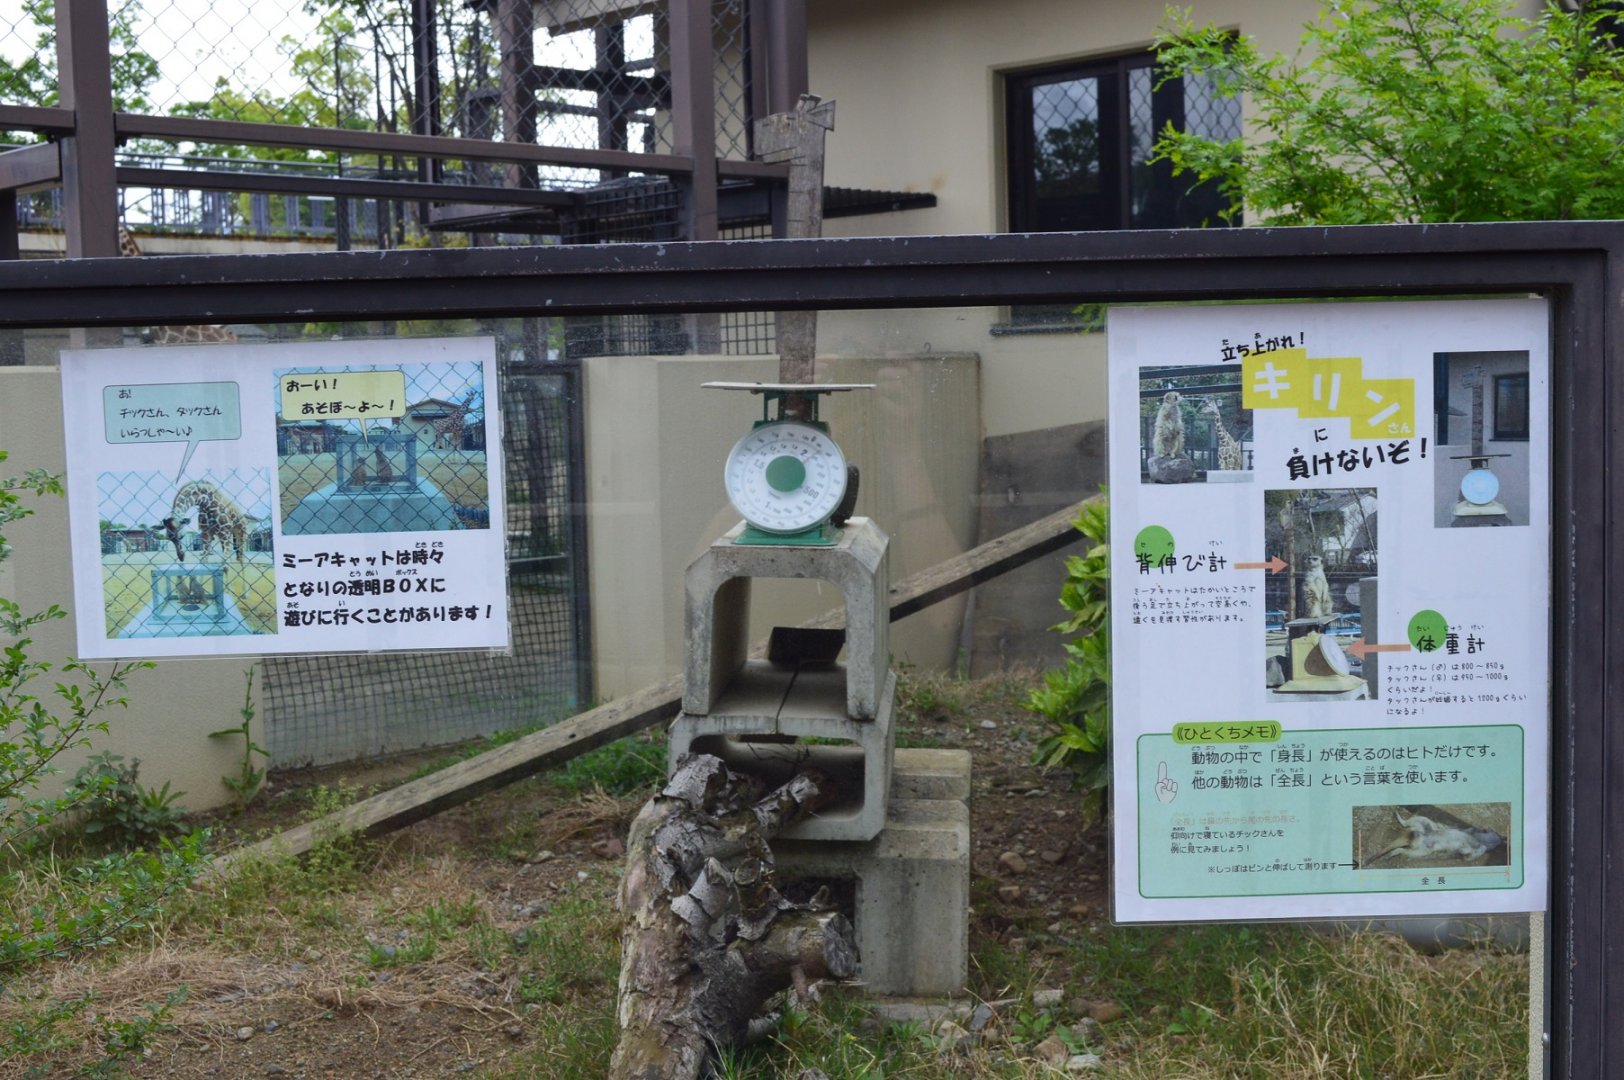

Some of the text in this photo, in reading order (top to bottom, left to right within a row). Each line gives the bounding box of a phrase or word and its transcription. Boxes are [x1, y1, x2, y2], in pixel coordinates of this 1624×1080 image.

[1220, 332, 1304, 362] 立ち上がれ！
[1253, 362, 1401, 427] キリン
[1314, 428, 1329, 443] に
[1286, 437, 1428, 481] 負けないぞ！
[282, 548, 444, 568] ミーアキャットは時々
[1136, 551, 1227, 575] 背伸び計
[283, 578, 446, 598] となりの透明BOXに
[284, 604, 492, 626] 遊びに行くことがあります！
[1416, 633, 1486, 655] 体重計
